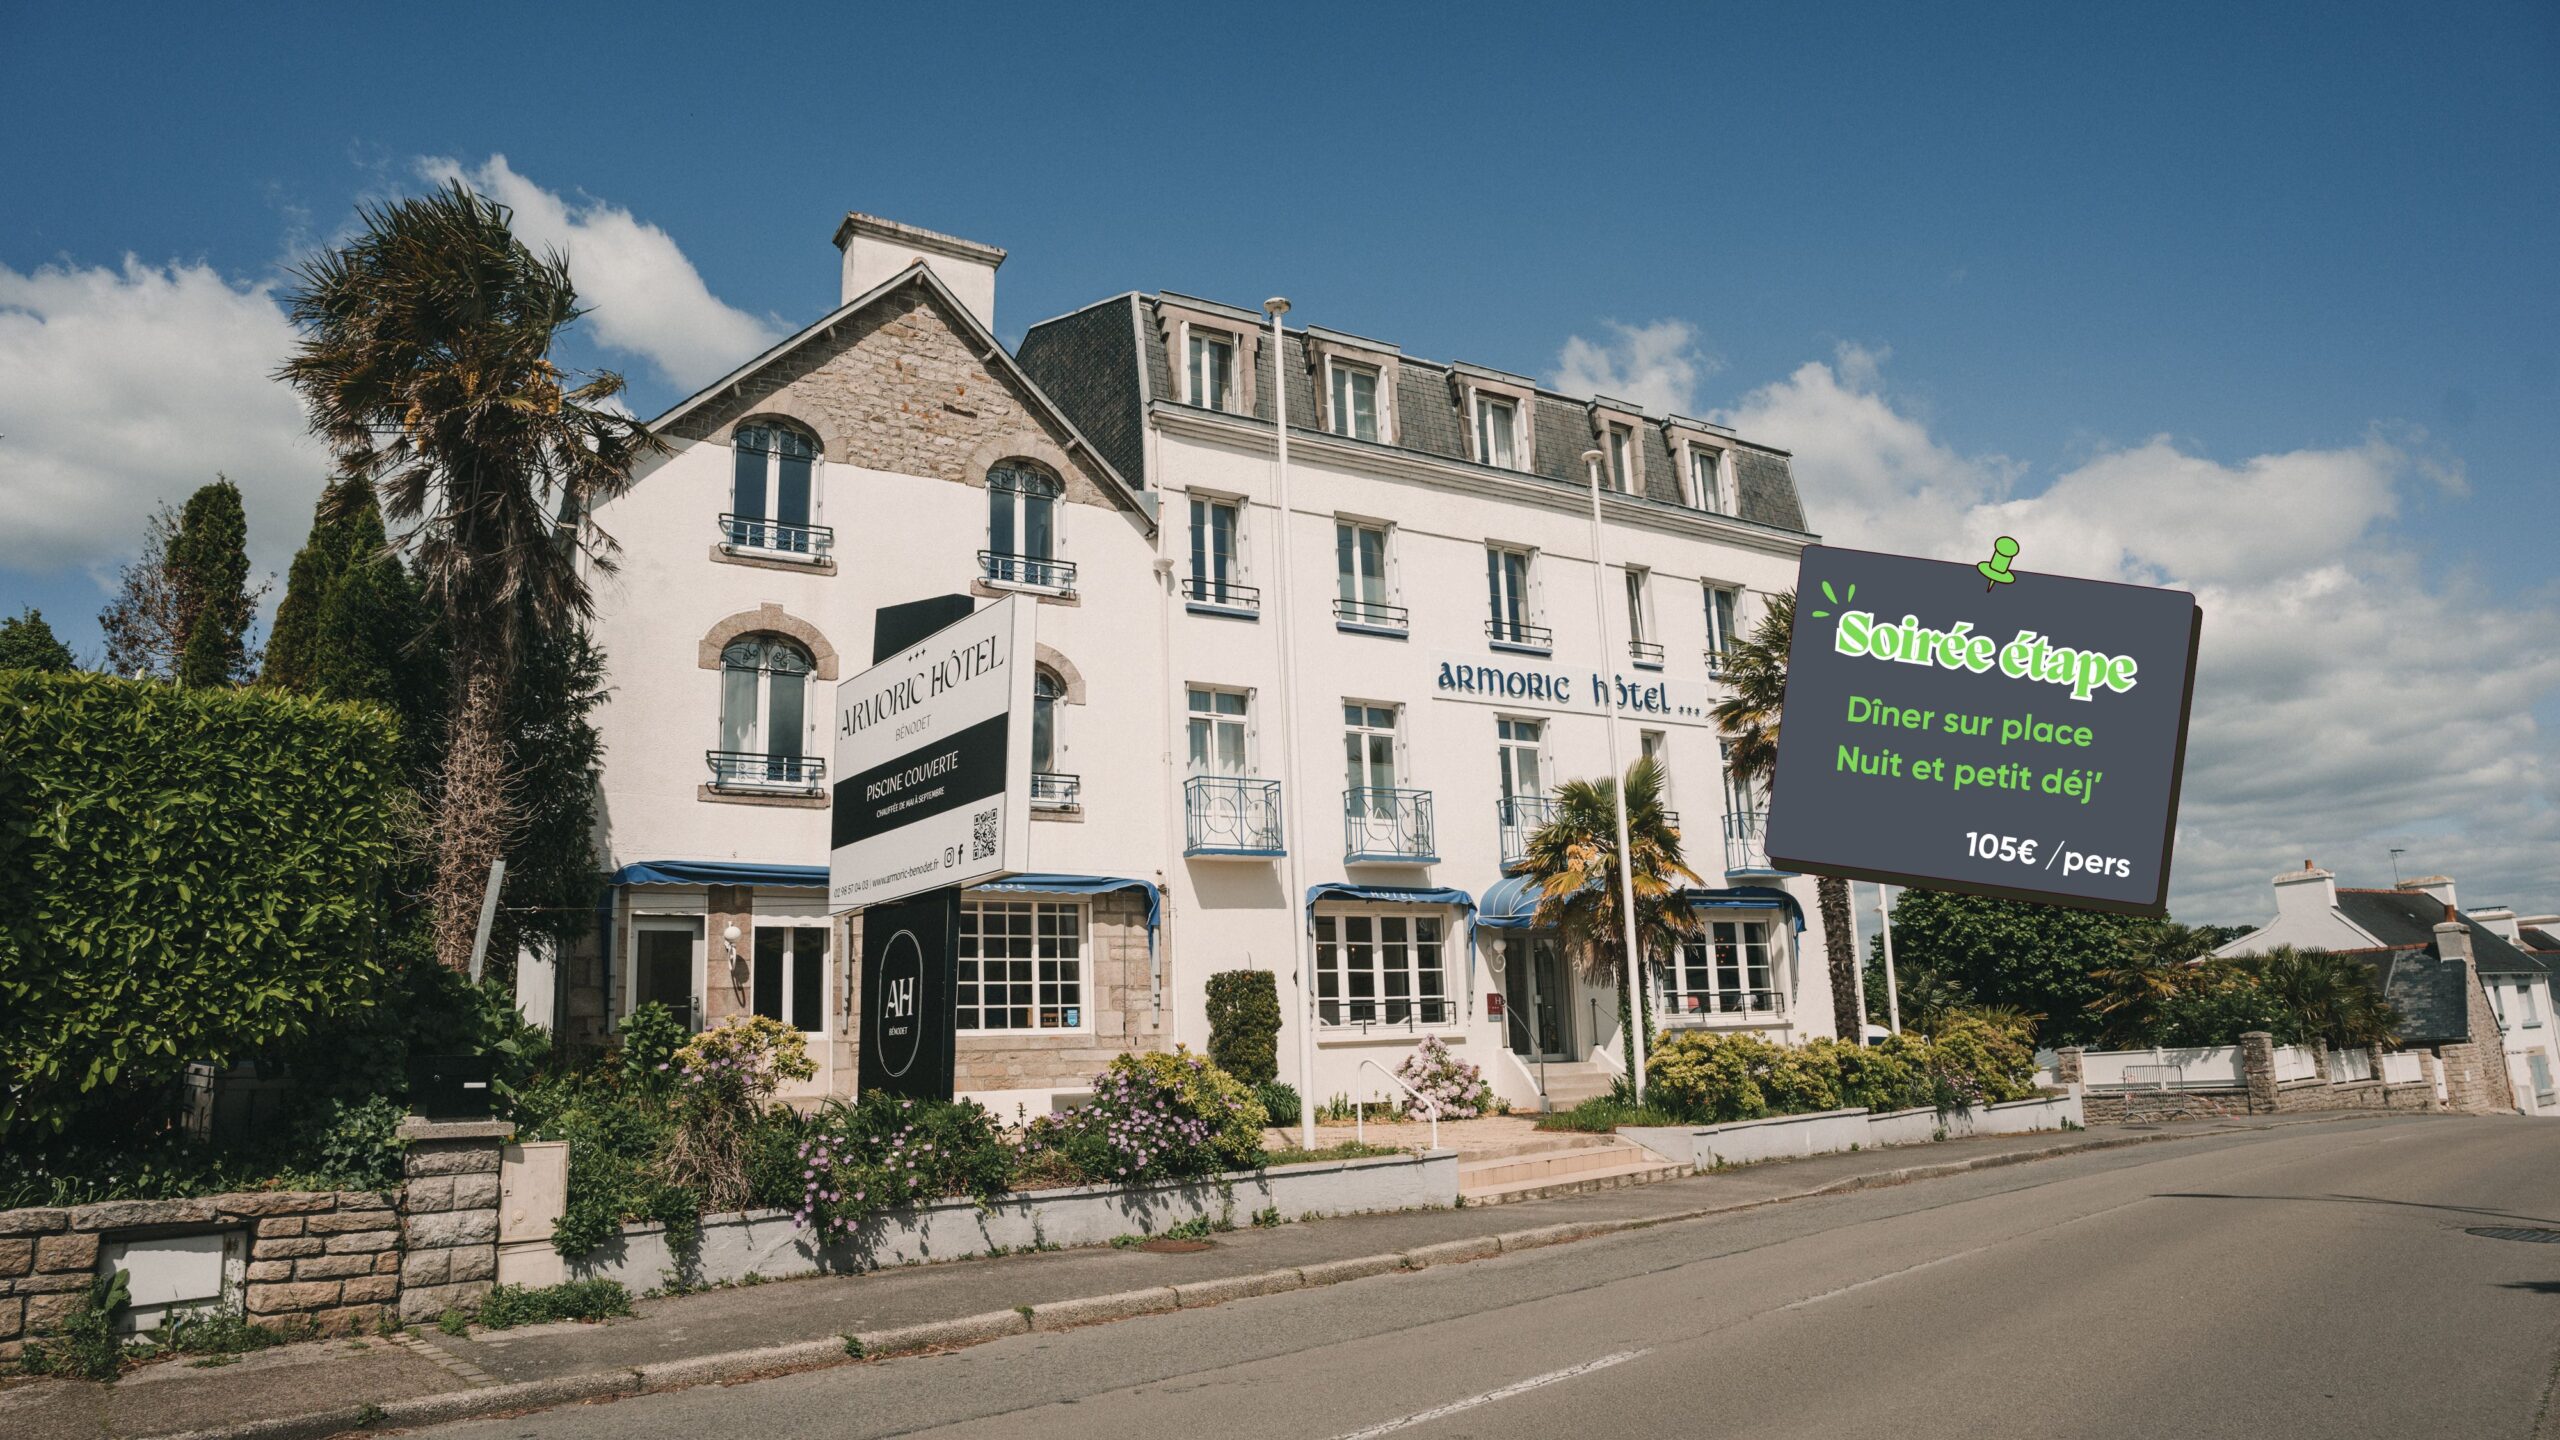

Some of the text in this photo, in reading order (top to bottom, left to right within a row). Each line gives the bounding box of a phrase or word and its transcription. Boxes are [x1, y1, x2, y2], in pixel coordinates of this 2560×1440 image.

[840, 635, 1005, 741] ARMORIC HÔTEL
[866, 750, 959, 802] PISCINE COUVERTE
[899, 800, 906, 811] DE
[918, 786, 945, 804] SEPTEMBRE
[884, 976, 915, 1018] AH
